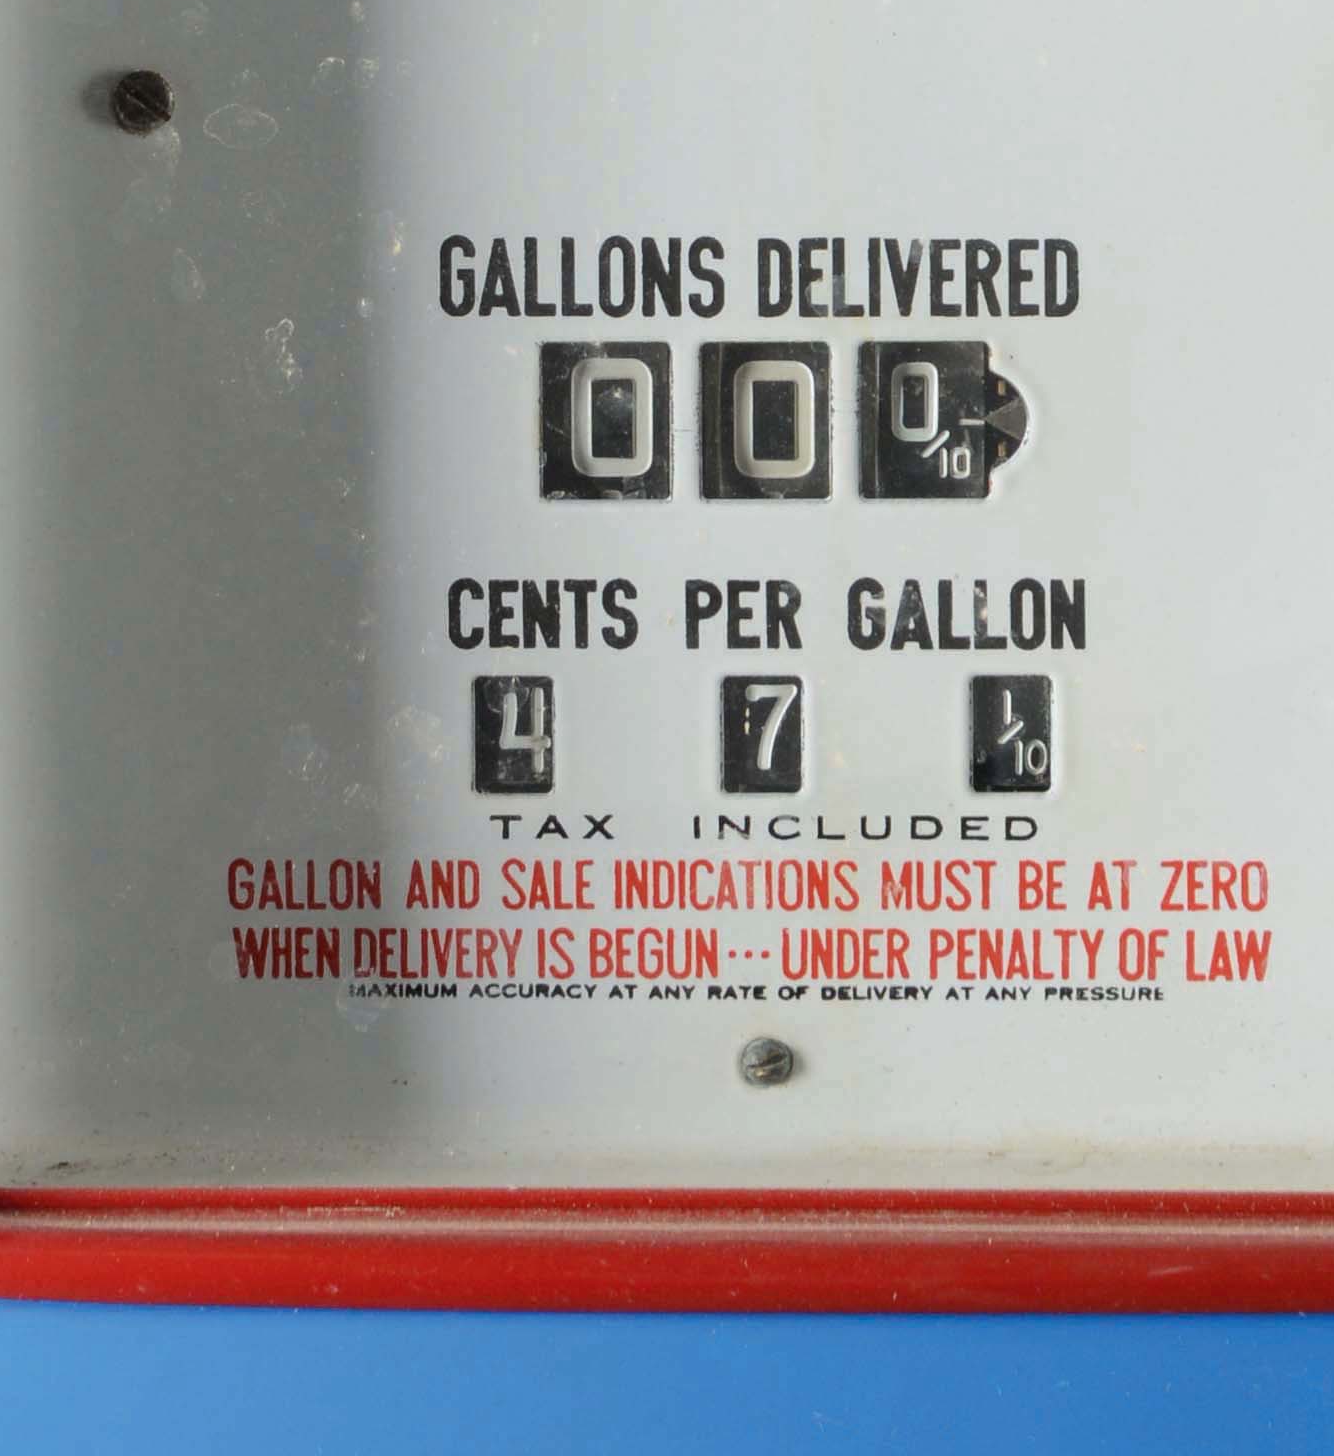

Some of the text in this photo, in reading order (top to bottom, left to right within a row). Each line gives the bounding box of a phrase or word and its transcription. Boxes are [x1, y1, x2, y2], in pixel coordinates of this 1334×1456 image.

[440, 235, 1079, 318] GALLONS DELIVERED
[448, 577, 1085, 650] CENTS PER GALLON
[499, 687, 551, 775] 4
[744, 683, 798, 770] 7
[490, 815, 1037, 841] TAX INCLUDED
[229, 857, 1268, 912] GALLON AND SALE INDICATIONS MUST BE AT ZERO
[233, 928, 339, 977] WHEN
[355, 928, 523, 979] DELIVERY
[537, 927, 575, 980] IS
[929, 928, 1104, 981] PENALTY
[1118, 927, 1170, 982] OF
[1185, 928, 1272, 982] LAW
[469, 984, 596, 999] ACCURACY
[609, 984, 637, 999] AT
[649, 986, 695, 1000] ANY
[708, 986, 766, 1000] RATE
[778, 986, 808, 1000] OF
[821, 986, 932, 1000] DELIVERY
[946, 987, 973, 1000] AT
[985, 987, 1031, 1000] ANY
[1045, 987, 1163, 1000] PRESSURE
